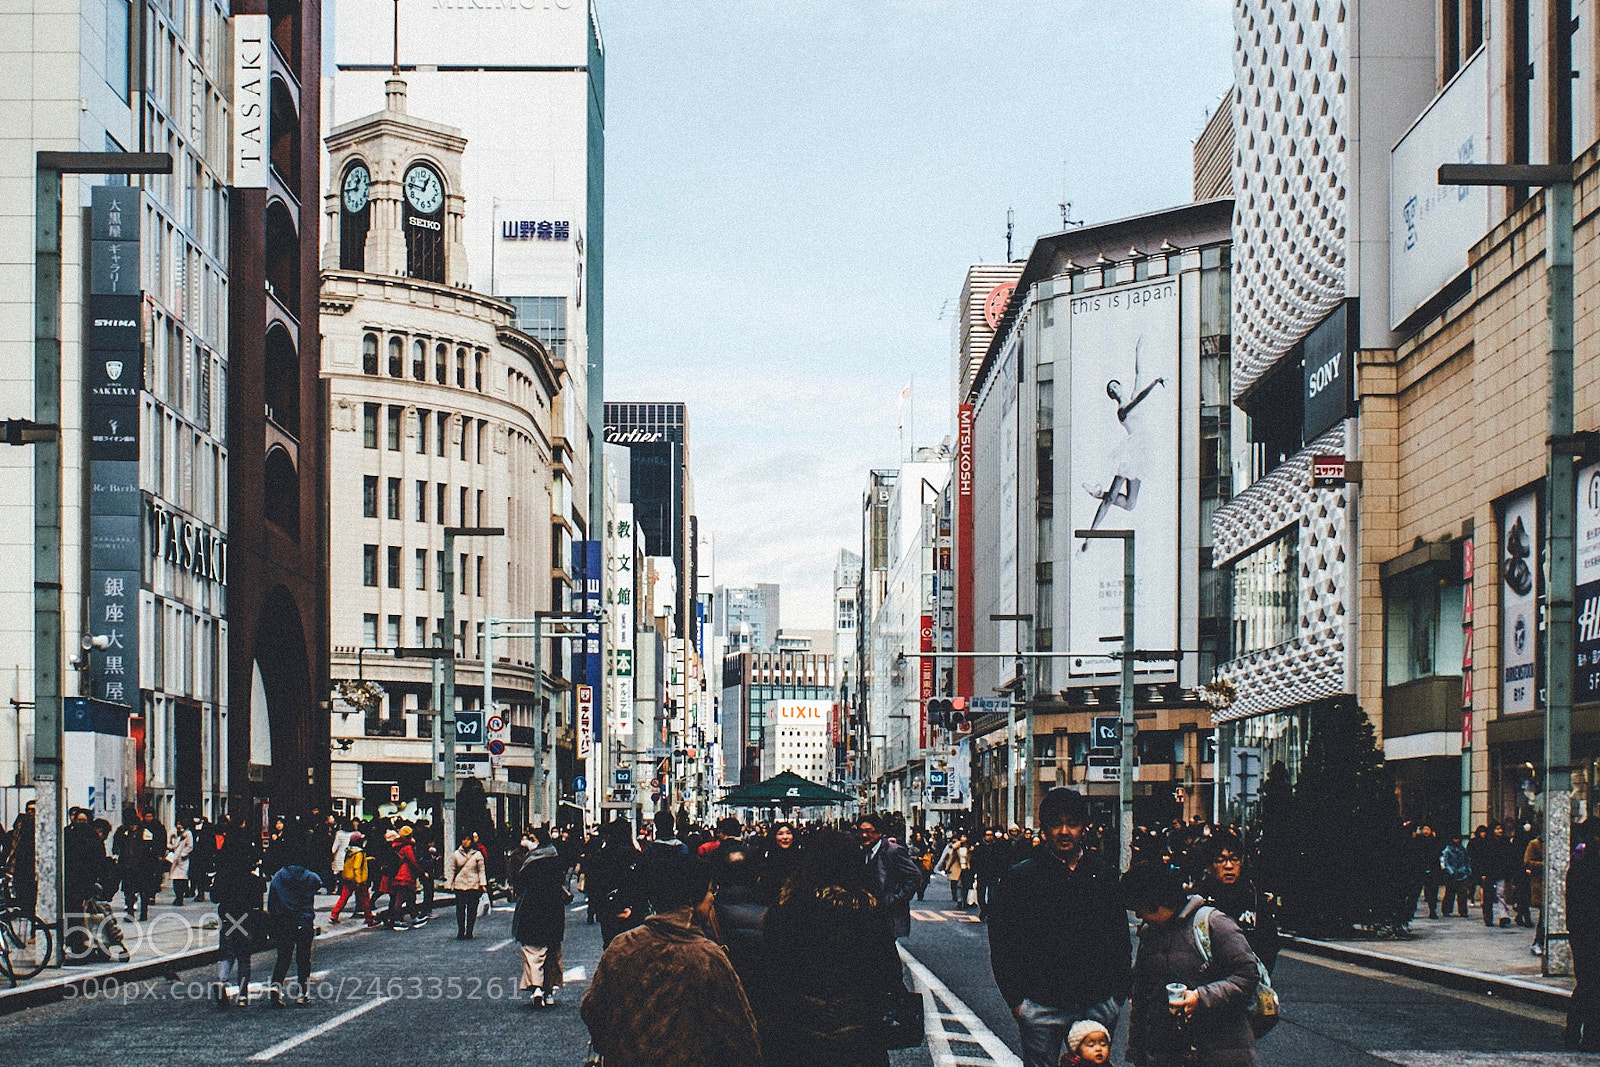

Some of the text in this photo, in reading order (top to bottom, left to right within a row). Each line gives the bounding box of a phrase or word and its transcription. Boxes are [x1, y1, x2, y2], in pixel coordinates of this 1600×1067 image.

[240, 37, 261, 169] TASAKI
[408, 216, 441, 231] SEIKO
[503, 220, 570, 239] 山野楽器
[1072, 285, 1177, 315] this is japan.
[94, 319, 136, 327] SHIMA
[1309, 352, 1342, 399] SONY
[93, 388, 136, 396] SAKAEYA
[960, 409, 971, 496] MITSUKOSHI
[154, 506, 228, 587] TASAKI
[617, 520, 631, 605] 教文館
[104, 576, 125, 701] 銀座大黒屋
[618, 652, 631, 673] 本
[782, 706, 821, 719] LIXIL
